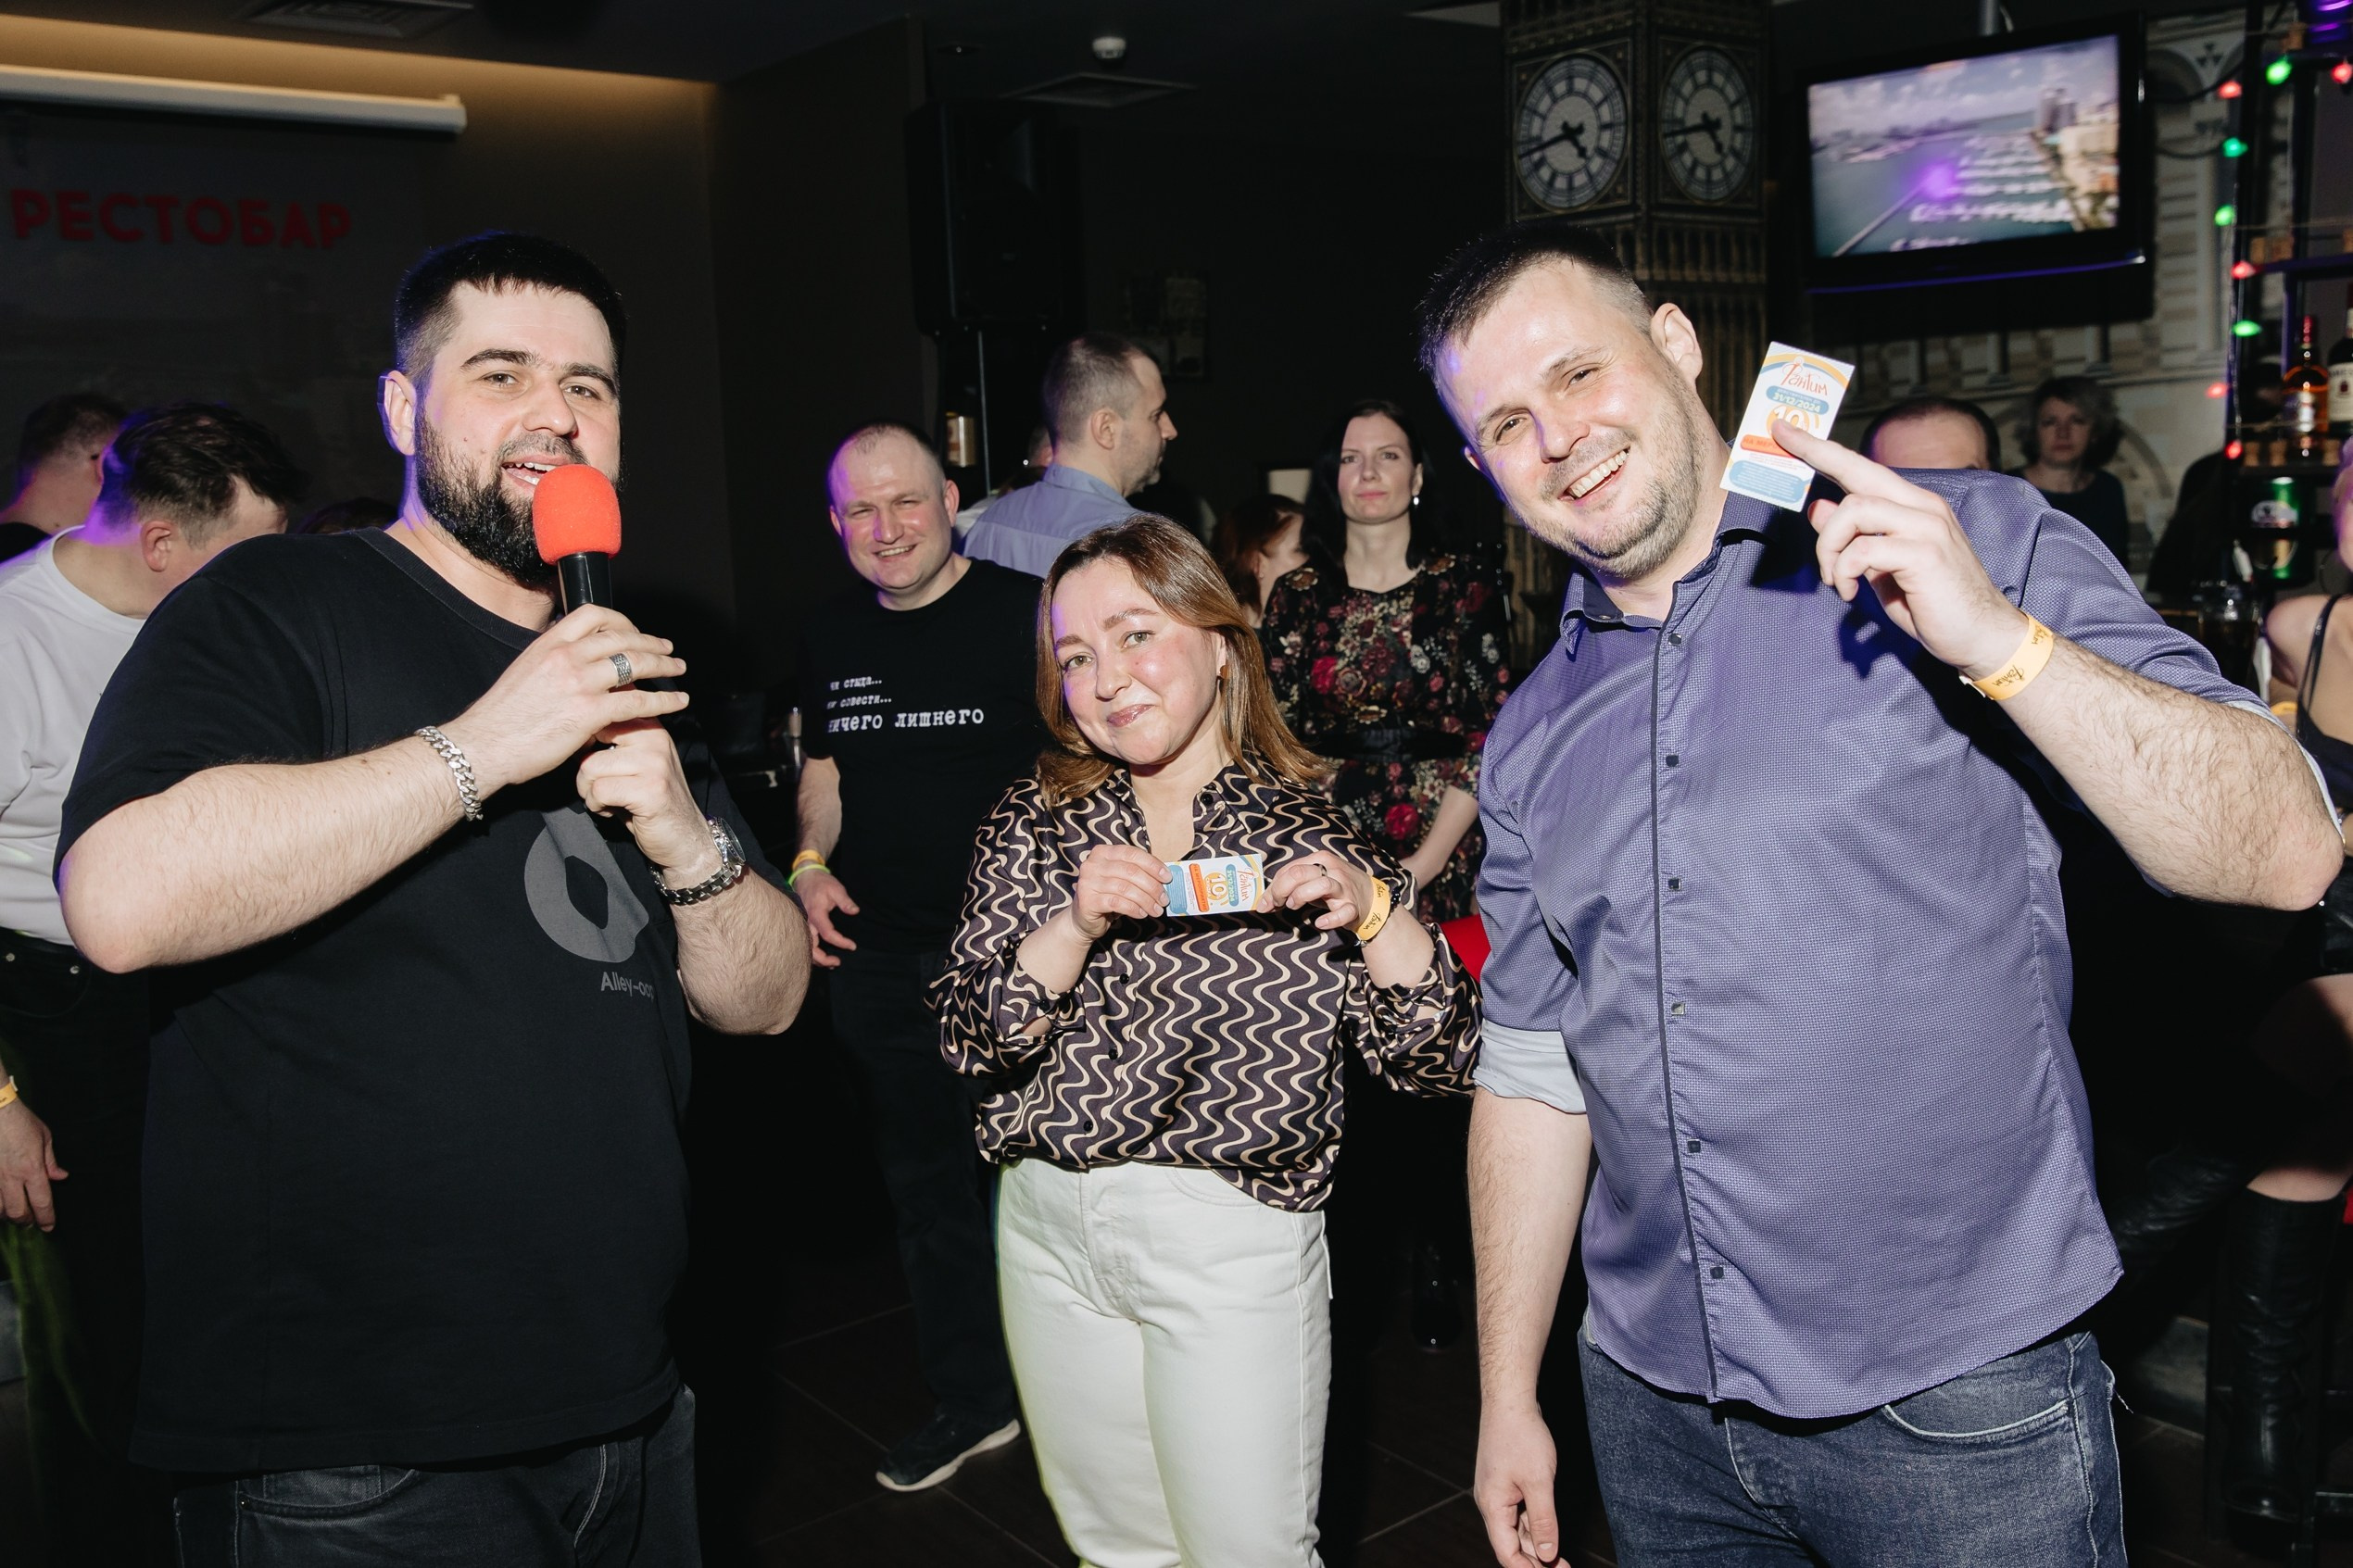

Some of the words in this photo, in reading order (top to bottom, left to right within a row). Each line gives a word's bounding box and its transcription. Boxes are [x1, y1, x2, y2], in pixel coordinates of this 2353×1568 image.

[10, 189, 352, 248] РЕСТОБАР
[1772, 392, 1822, 413] 31/12/2024
[894, 708, 985, 728] лишнего
